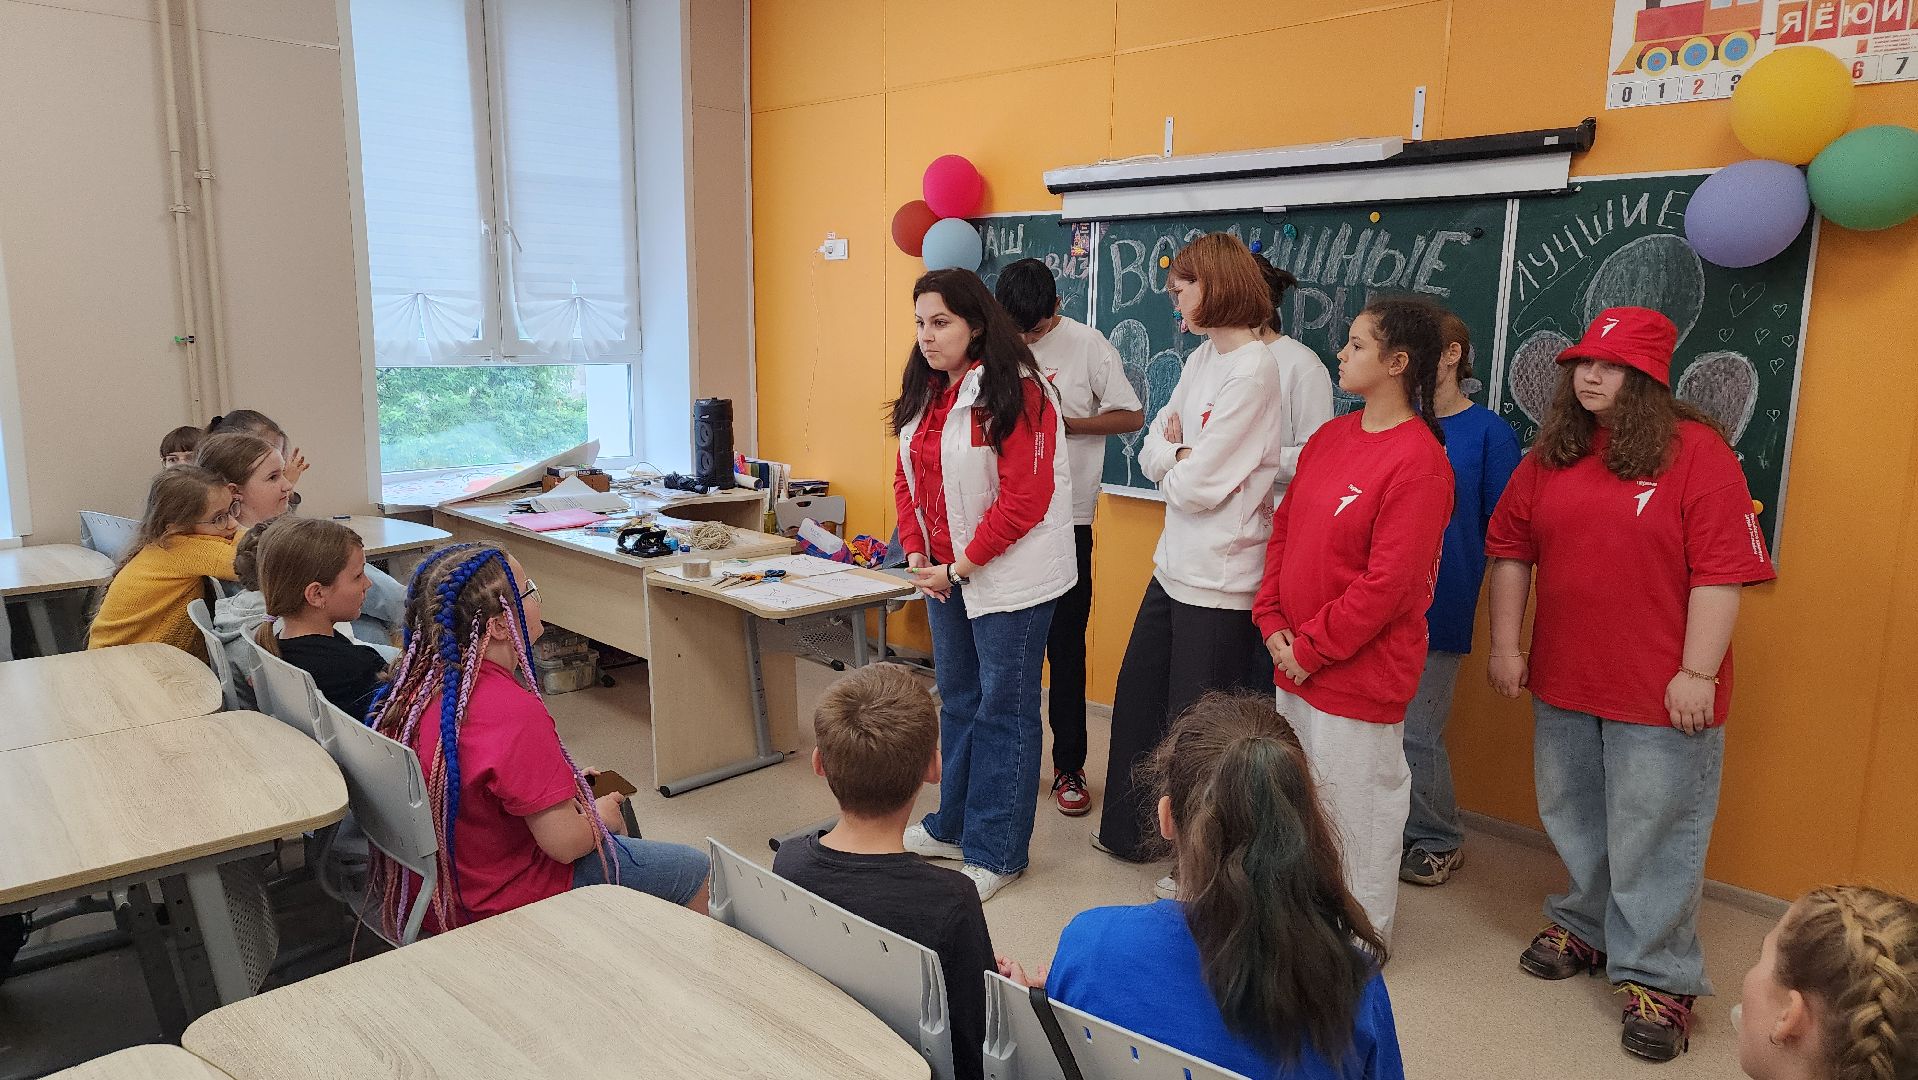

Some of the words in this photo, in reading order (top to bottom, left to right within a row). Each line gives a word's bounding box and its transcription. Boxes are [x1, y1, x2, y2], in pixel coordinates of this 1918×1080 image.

[1780, 10, 1802, 34] Я
[1814, 2, 1836, 30] Ё
[1842, 3, 1873, 25] Ю
[1621, 86, 1633, 103] 0
[1658, 82, 1666, 99] 1
[1692, 78, 1705, 96] 2
[1852, 60, 1865, 79] 6
[1895, 56, 1910, 76] 7
[979, 222, 1025, 260] АШ
[1516, 189, 1690, 302] ЛУЧШИЕ
[1044, 252, 1090, 280] ВИЗ
[1110, 221, 1473, 314] ВОУШНЫЕ
